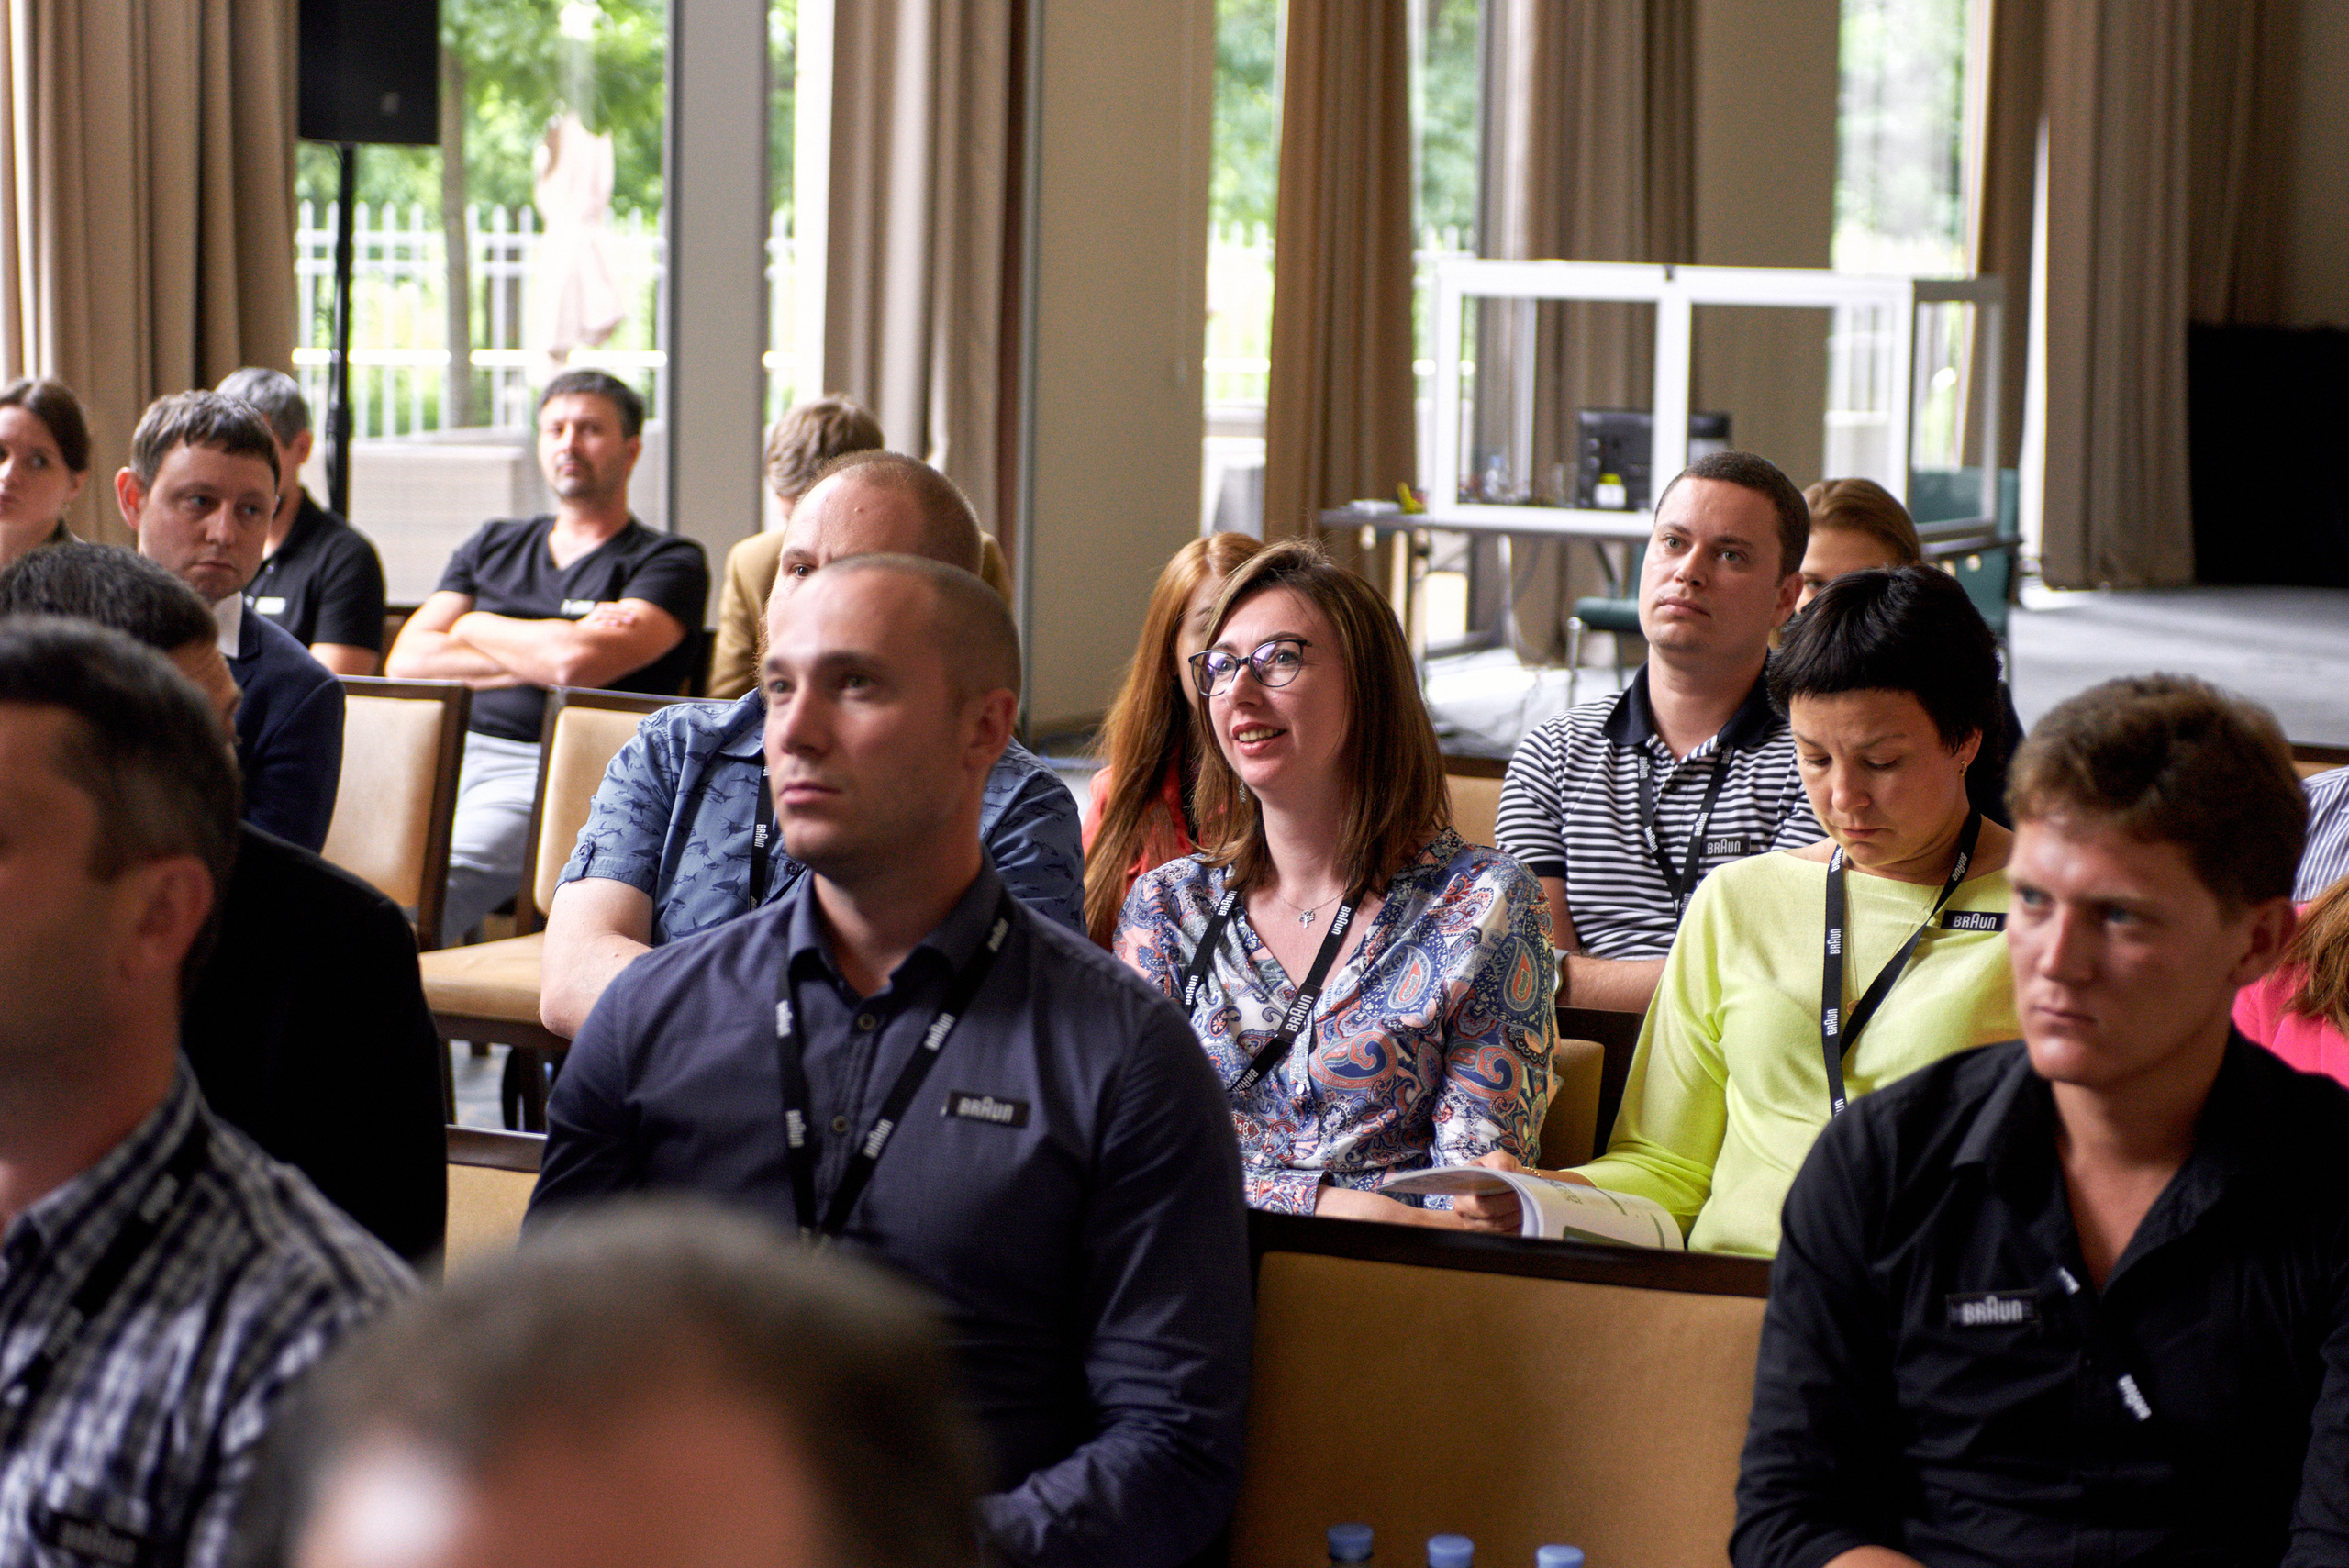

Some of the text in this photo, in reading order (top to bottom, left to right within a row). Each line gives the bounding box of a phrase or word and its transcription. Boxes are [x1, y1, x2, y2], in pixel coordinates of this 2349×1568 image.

[1694, 812, 1709, 837] BRAUN
[1707, 838, 1741, 855] BRAUN
[1217, 889, 1238, 917] BRAUN
[1331, 906, 1351, 936] BRAUN
[1953, 913, 1998, 929] BRAUN
[1827, 928, 1842, 955] BRAUN
[1185, 974, 1199, 1006] BRAUN
[1285, 994, 1315, 1033] BRAUN
[1824, 1008, 1839, 1037] BRAUN
[957, 1095, 1015, 1122] BRAUN
[1961, 1295, 2023, 1326] BRAUN
